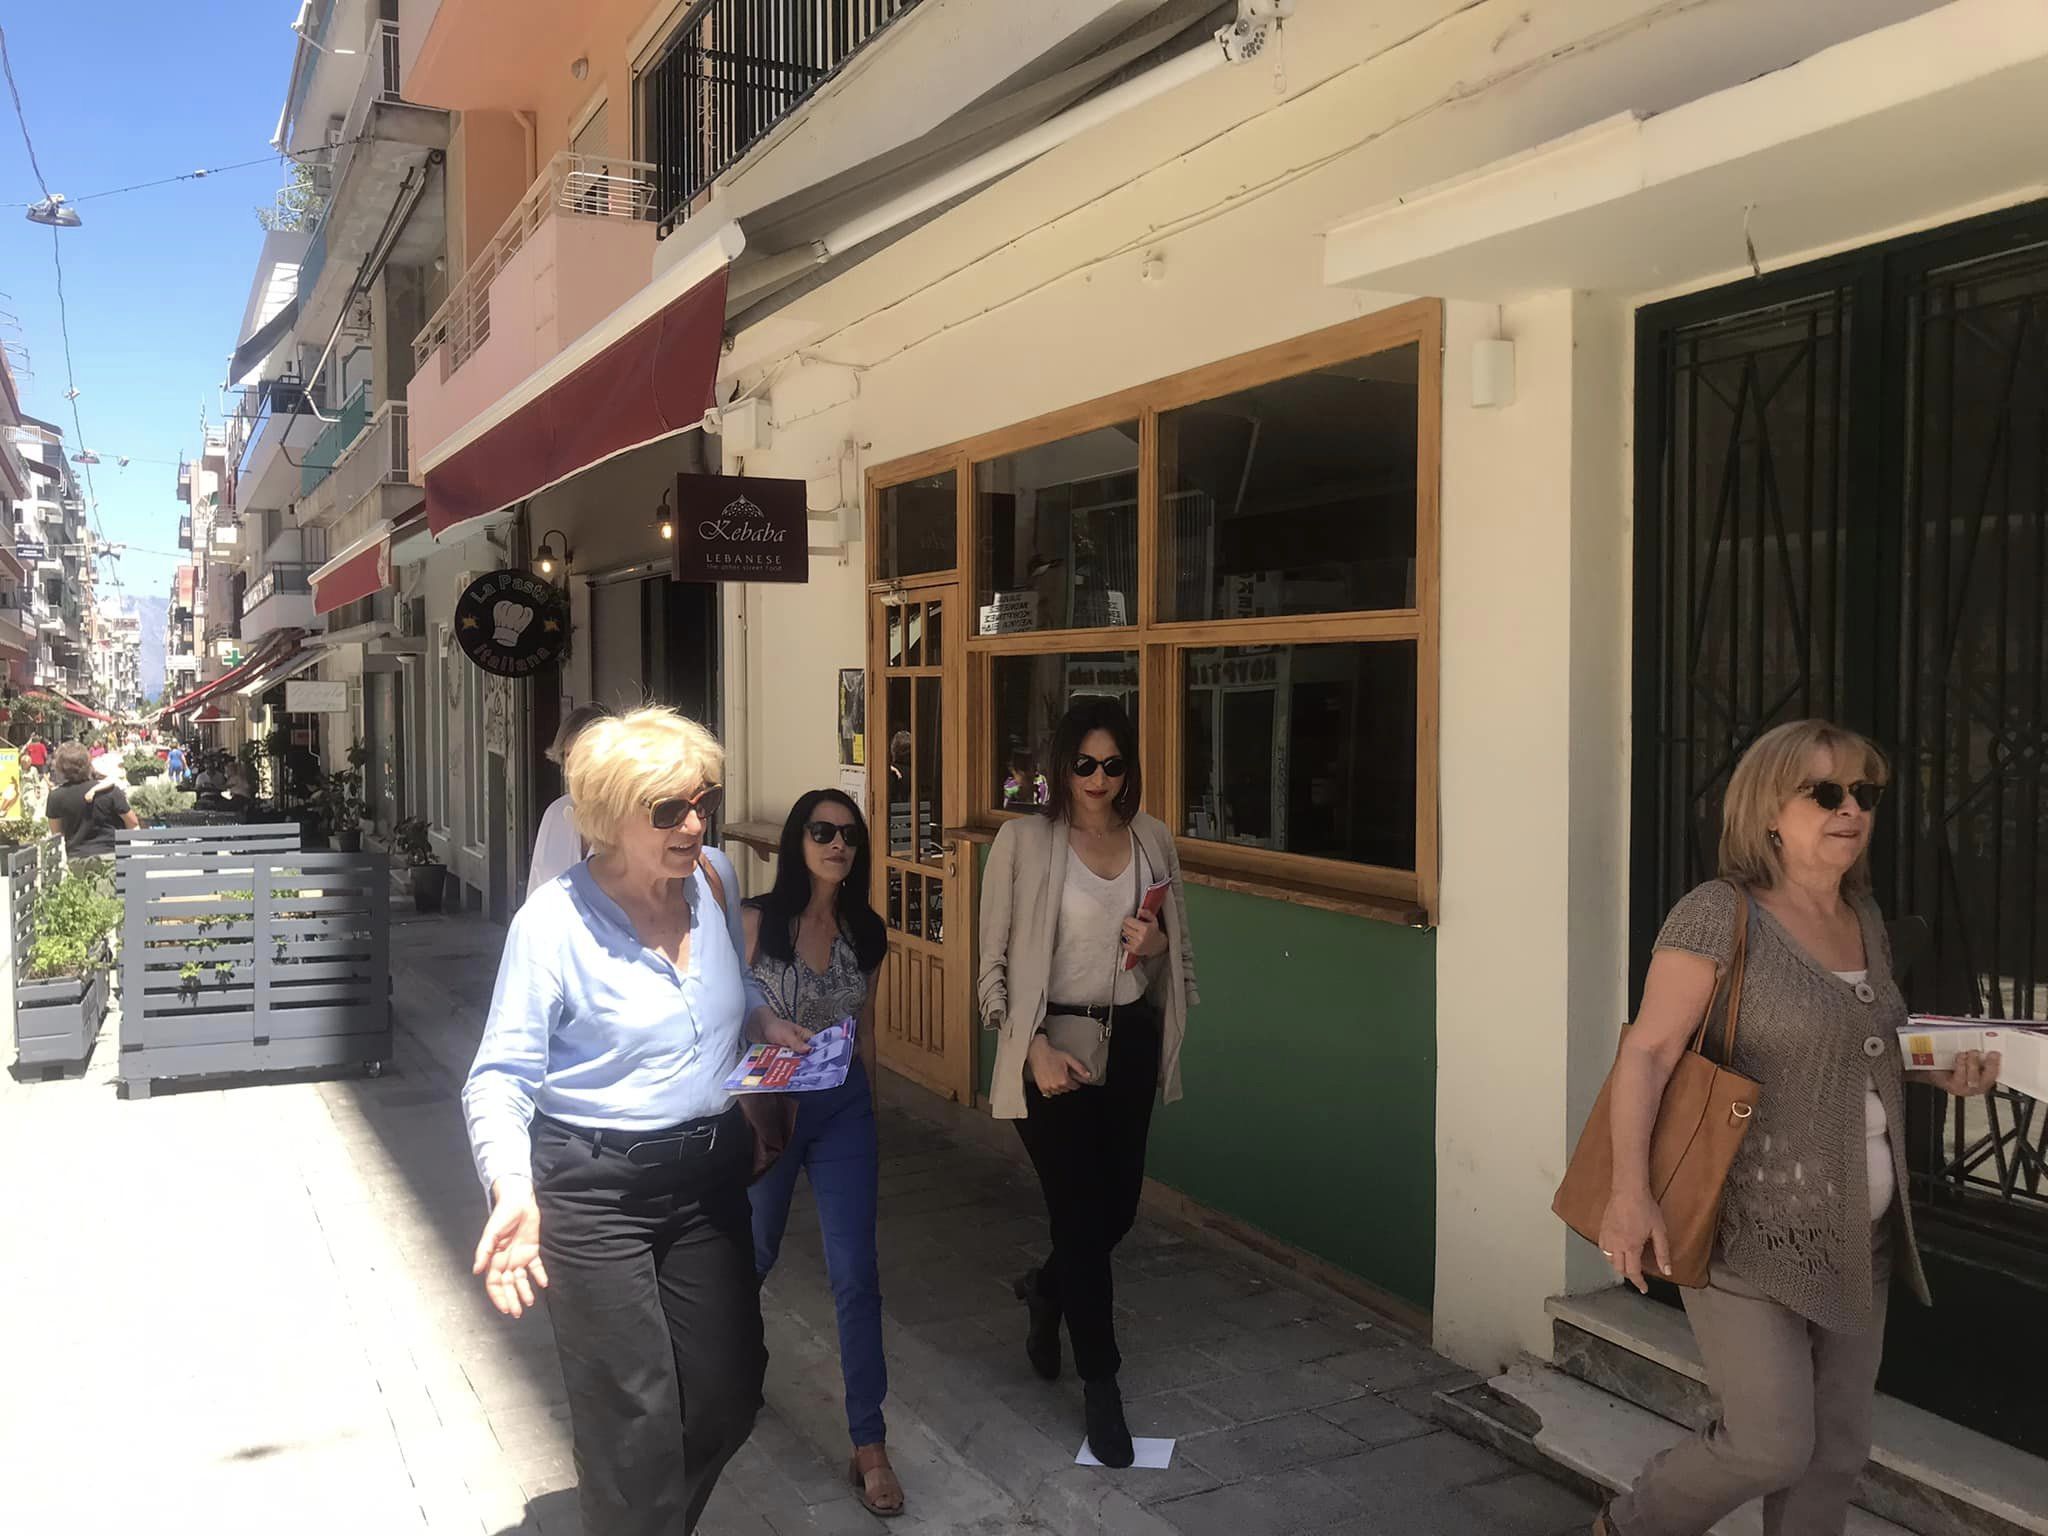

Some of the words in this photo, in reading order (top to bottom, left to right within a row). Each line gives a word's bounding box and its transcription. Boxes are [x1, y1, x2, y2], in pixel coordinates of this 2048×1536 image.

[699, 520, 786, 542] Kebaba
[706, 554, 781, 565] LEBANESE
[470, 583, 497, 604] La
